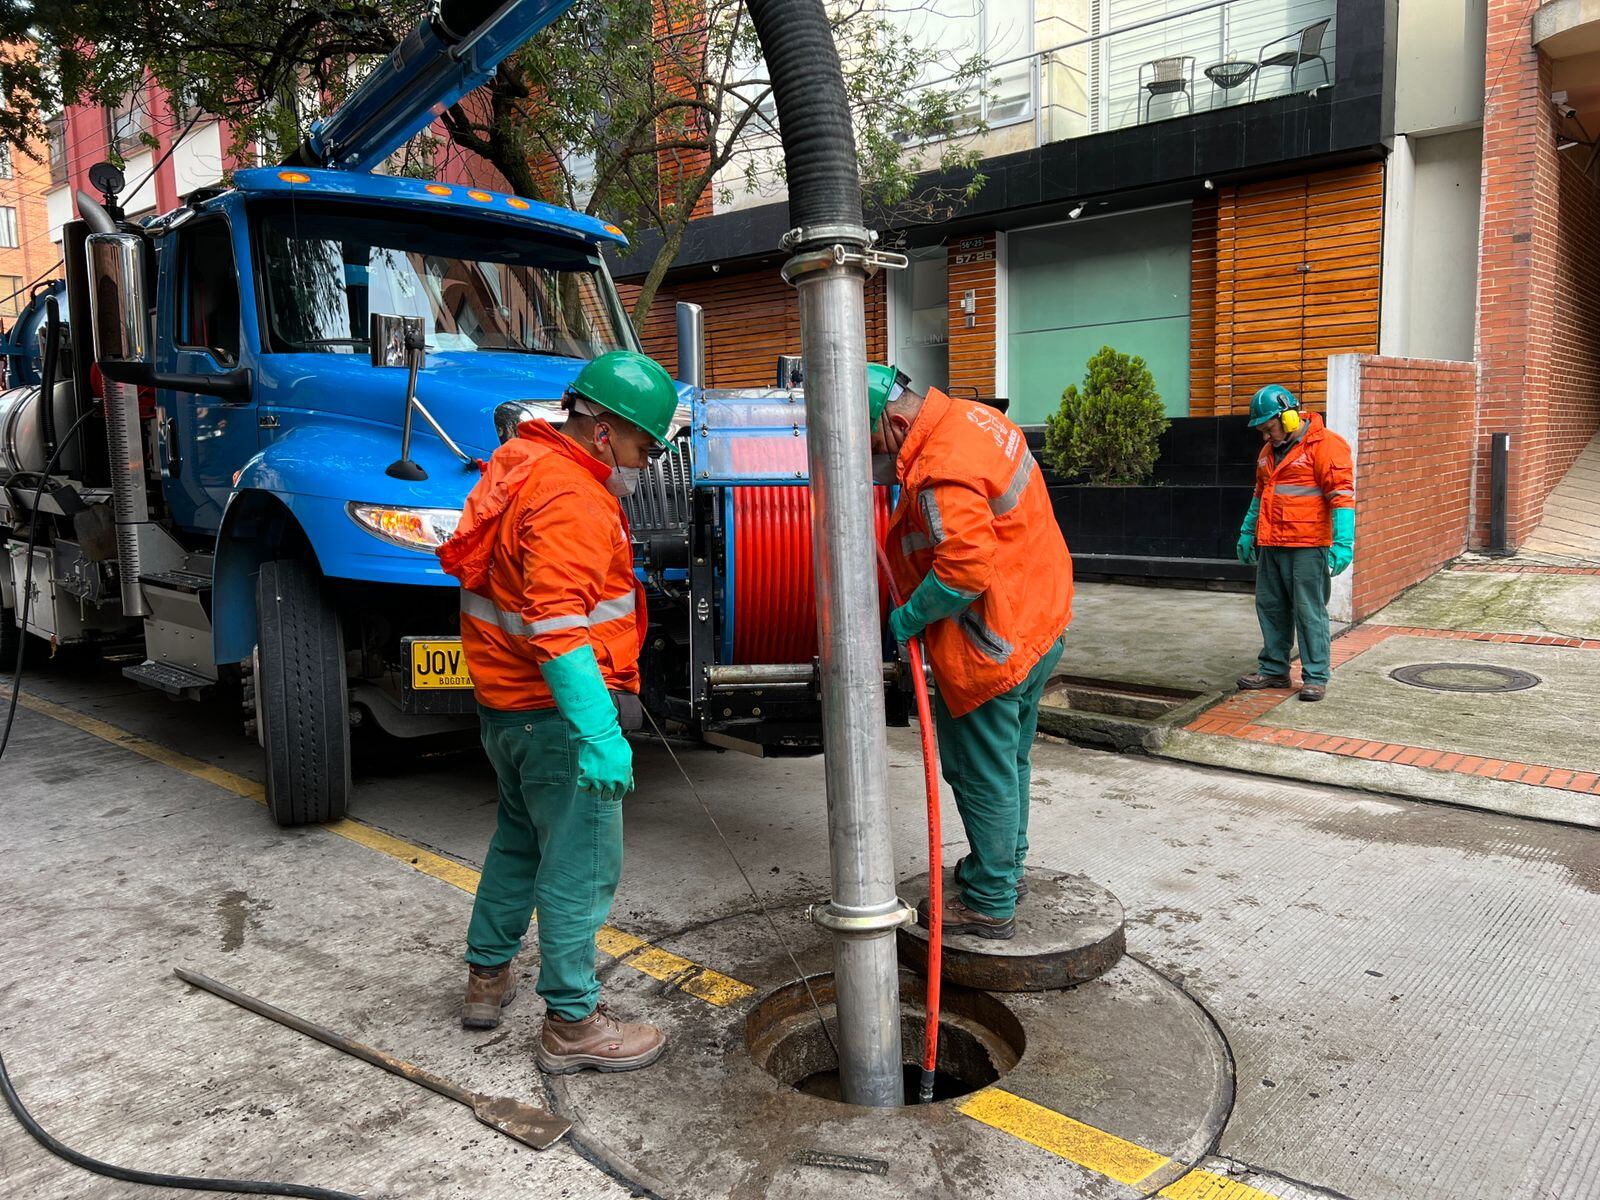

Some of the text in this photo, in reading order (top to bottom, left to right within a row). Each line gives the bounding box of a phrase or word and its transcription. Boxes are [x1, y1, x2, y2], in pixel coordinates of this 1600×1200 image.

[905, 333, 943, 345] FLINI
[417, 650, 460, 675] JQV
[440, 677, 471, 685] BOGOTA
